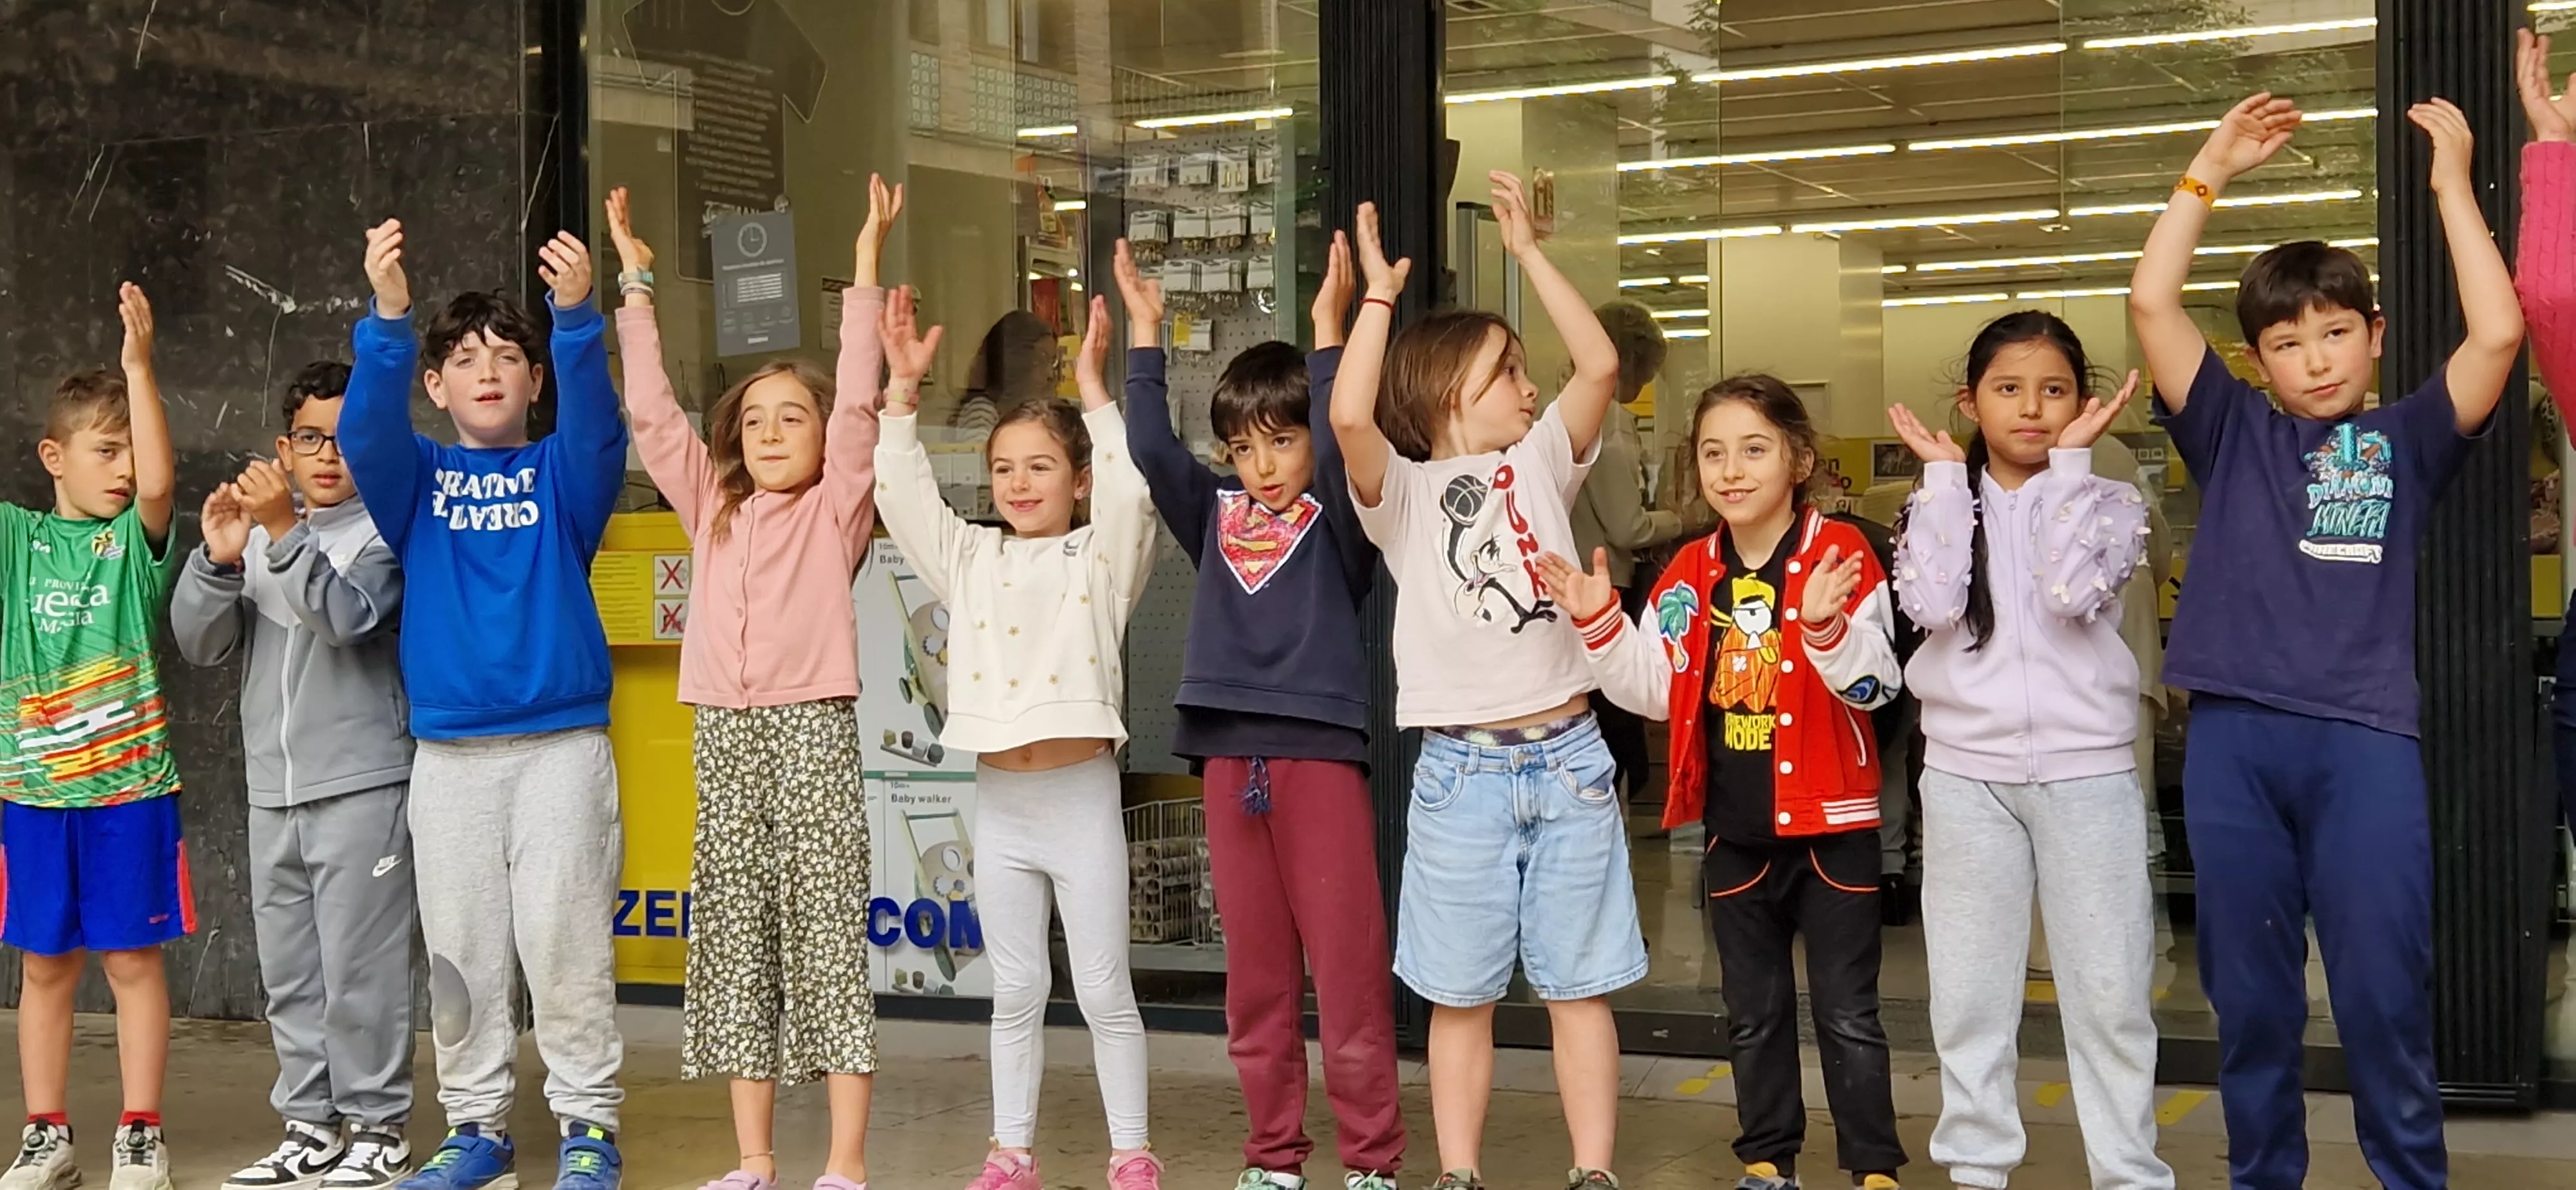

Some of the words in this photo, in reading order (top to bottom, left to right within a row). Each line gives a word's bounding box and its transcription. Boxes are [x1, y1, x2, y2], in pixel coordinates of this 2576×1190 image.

[2307, 475, 2394, 509] DIAMOND
[879, 554, 905, 566] Baby
[1725, 725, 1772, 751] MODE
[891, 793, 916, 805] Baby
[917, 793, 952, 804] walker
